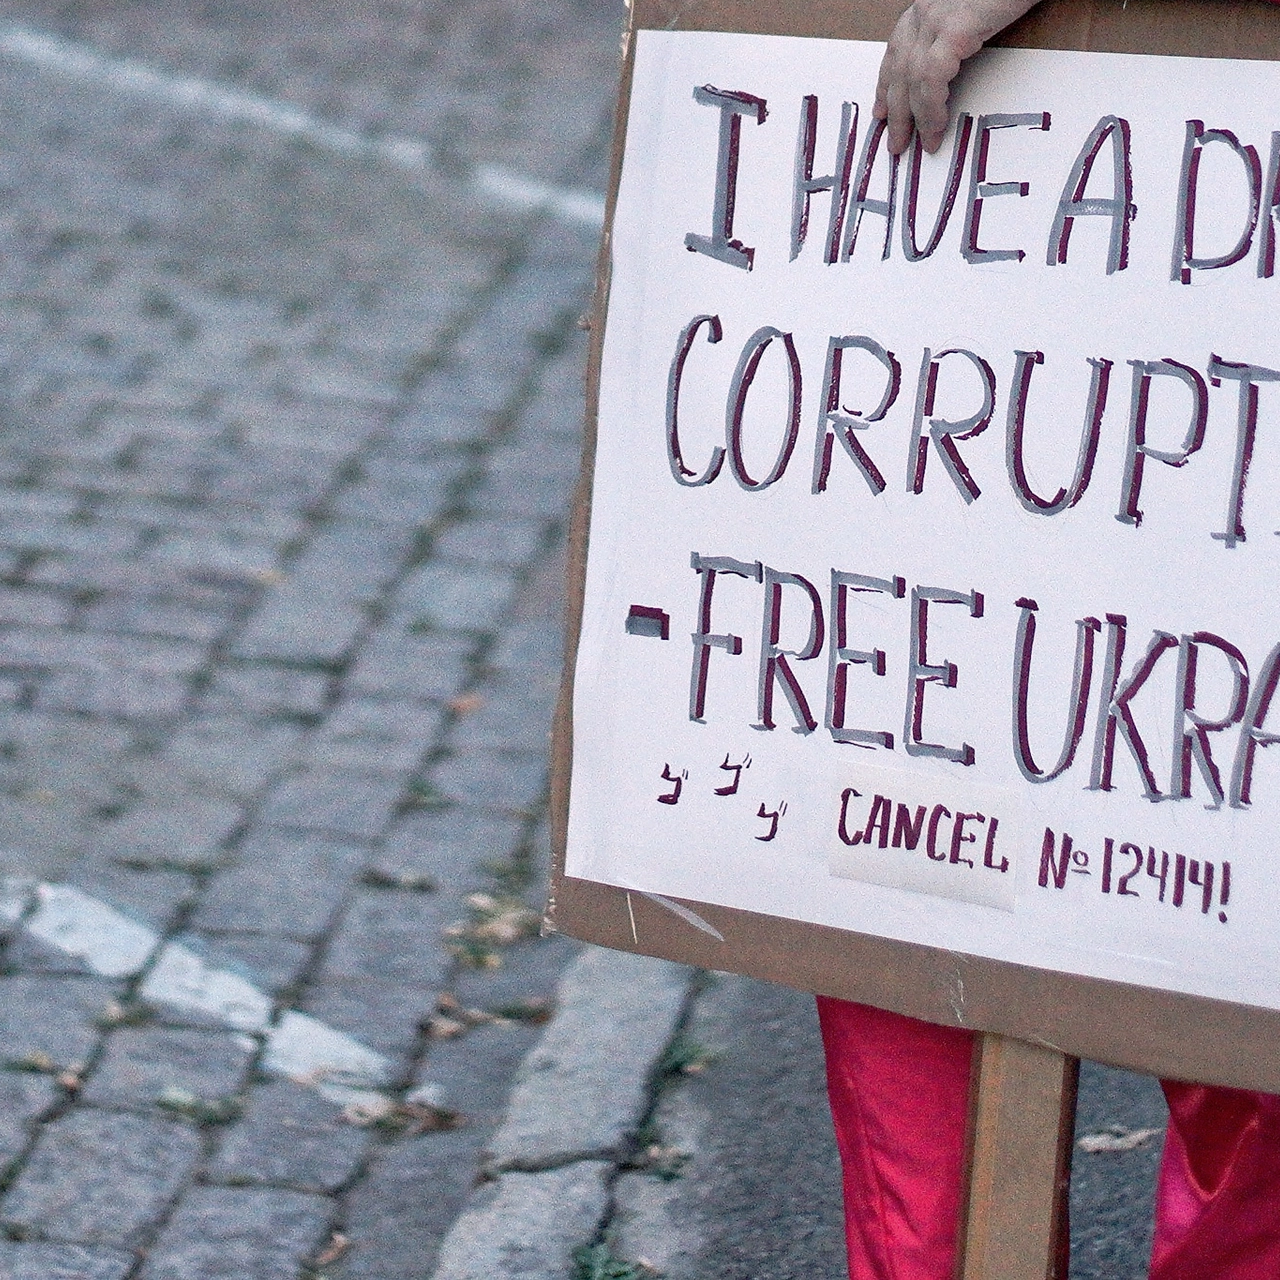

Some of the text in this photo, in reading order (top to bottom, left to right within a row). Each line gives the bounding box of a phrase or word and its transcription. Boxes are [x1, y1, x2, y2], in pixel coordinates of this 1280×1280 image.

[683, 83, 770, 272] I
[1046, 114, 1139, 276] A
[624, 551, 985, 766] -FREE
[838, 787, 1010, 873] CANCEL
